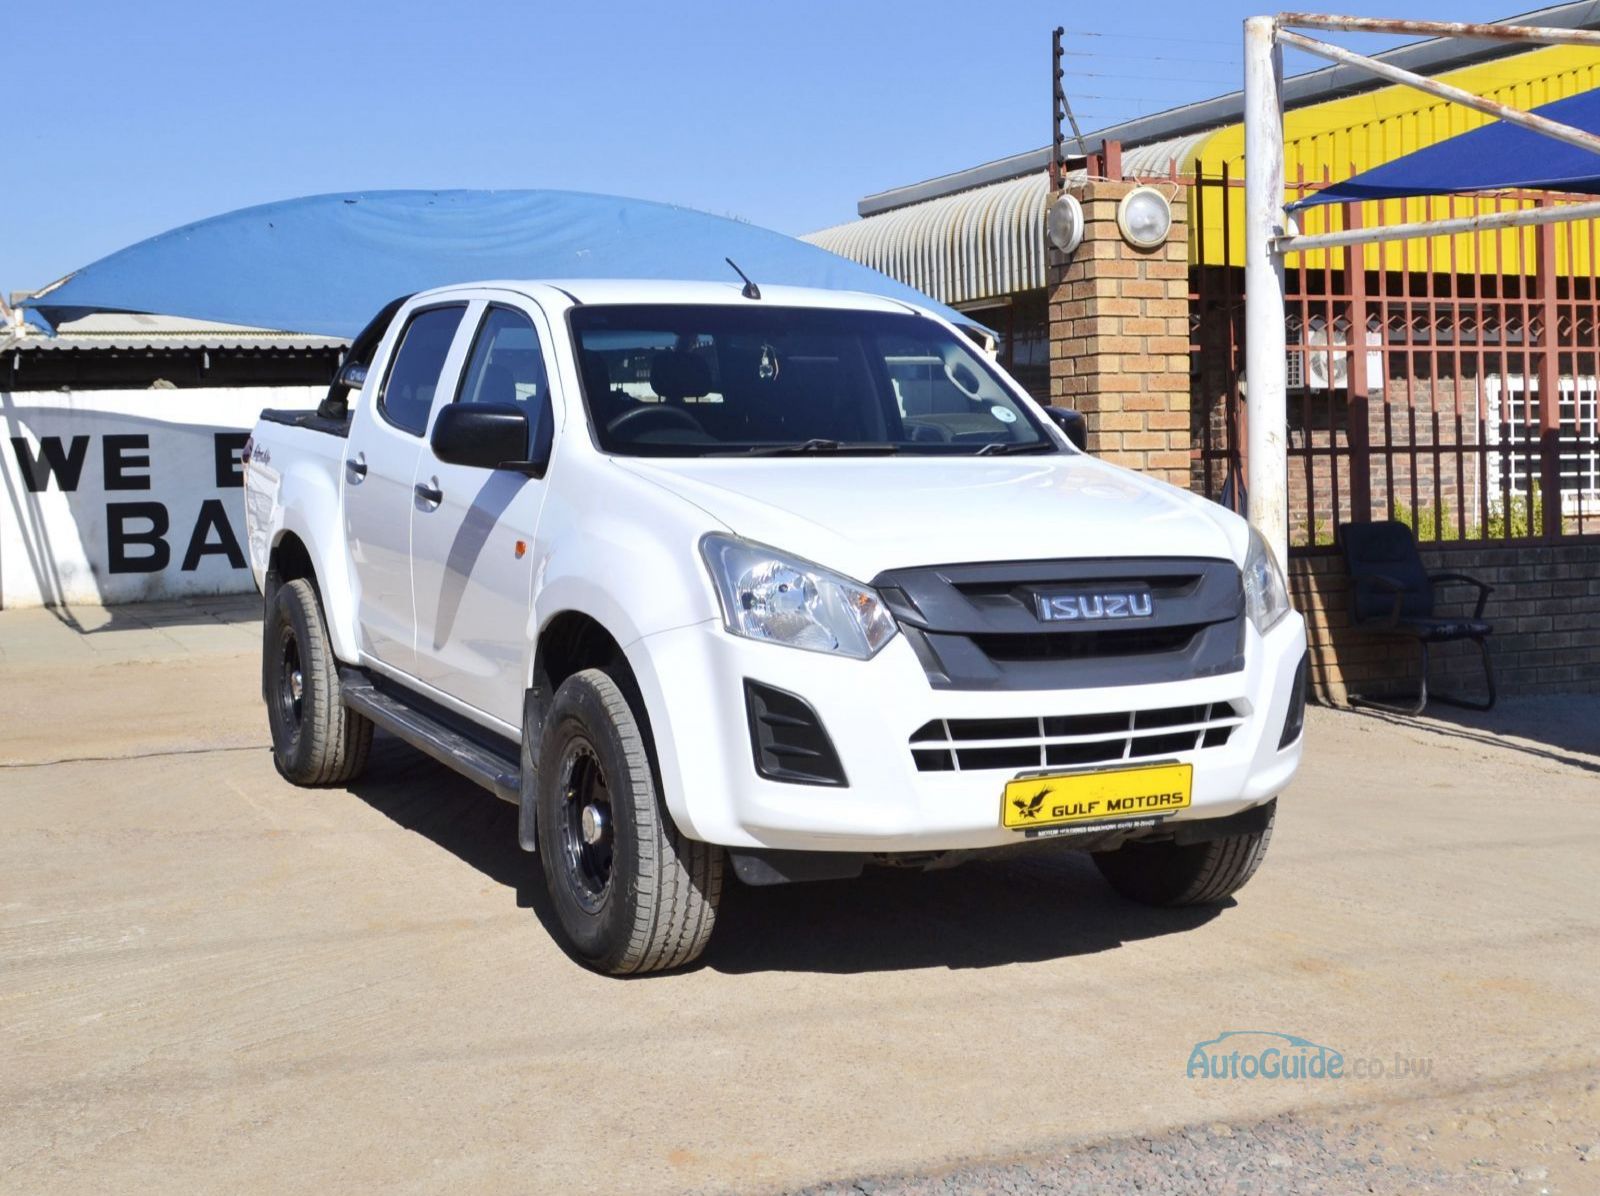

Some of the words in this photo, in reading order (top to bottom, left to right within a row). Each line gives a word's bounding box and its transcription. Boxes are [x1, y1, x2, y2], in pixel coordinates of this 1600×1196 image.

[11, 434, 150, 492] WE
[1040, 593, 1152, 620] ISUZU
[1052, 801, 1100, 817] GULF
[1107, 792, 1183, 812] MOTORS
